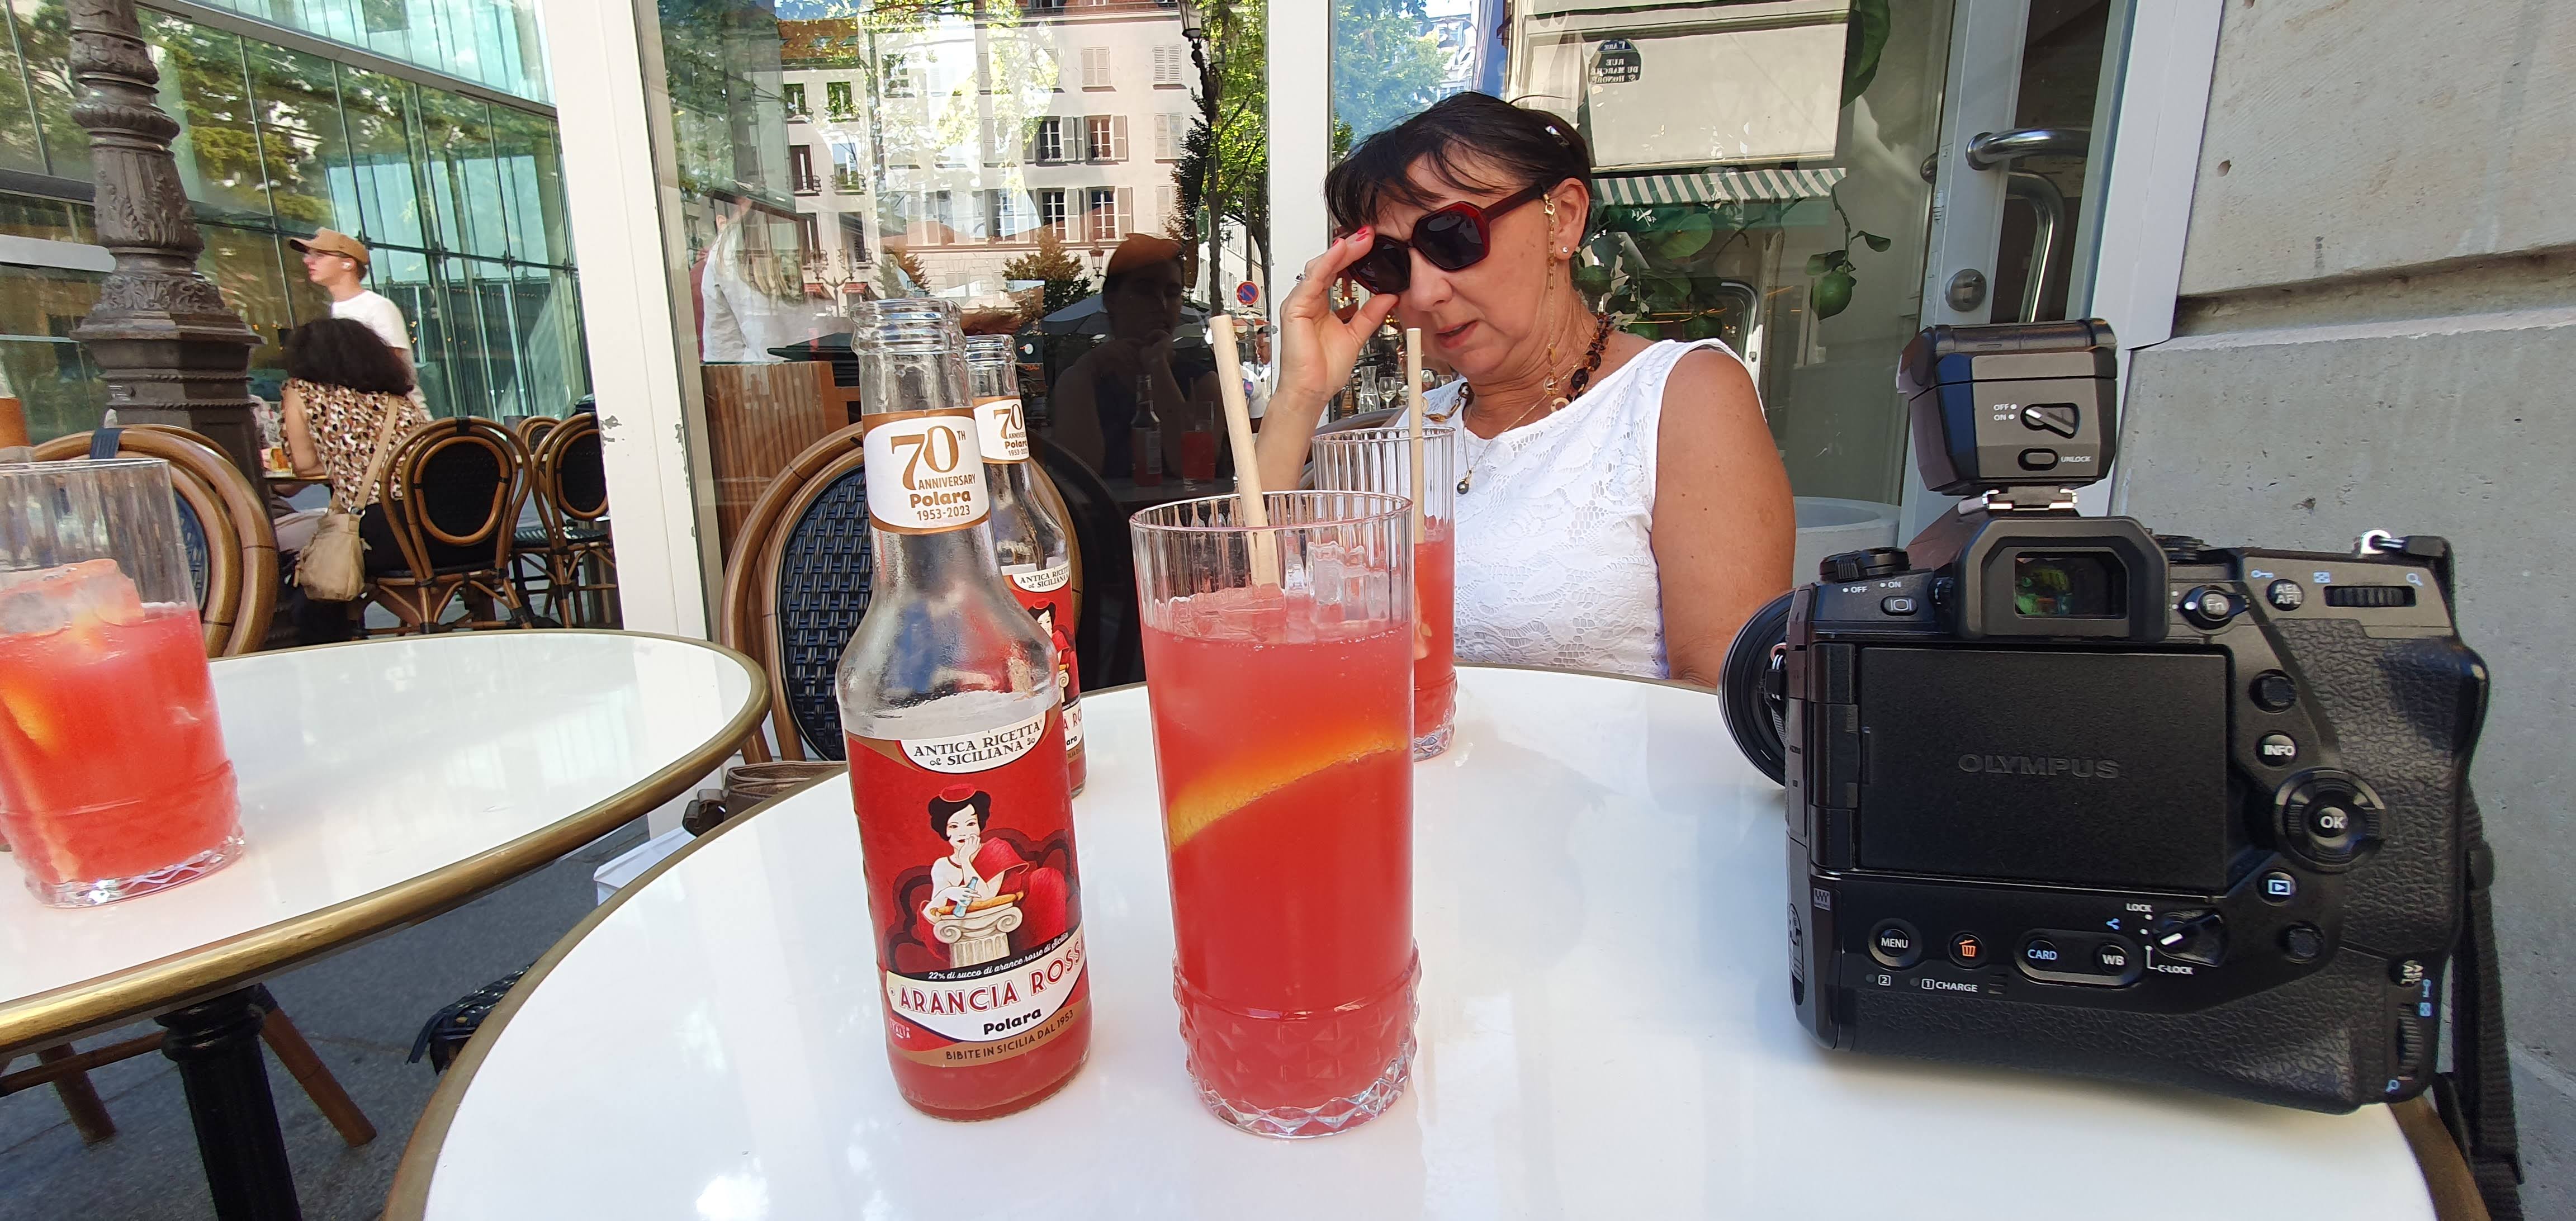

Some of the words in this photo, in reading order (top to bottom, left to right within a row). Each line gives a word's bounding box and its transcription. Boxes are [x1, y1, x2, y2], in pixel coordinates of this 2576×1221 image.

[993, 404, 1023, 439] 70
[918, 474, 976, 490] ANNIVERSARY
[910, 490, 972, 508] Polara
[917, 505, 970, 521] 1953-2023
[1020, 573, 1050, 584] ANTICA
[2275, 584, 2301, 594] AEL
[2206, 599, 2227, 610] Fn
[2275, 595, 2302, 604] AFL
[914, 740, 977, 757] ANTICA
[982, 722, 1041, 749] RICETTA
[947, 741, 1024, 766] SICILIANA
[2264, 744, 2295, 756] INFO
[1958, 754, 2120, 779] OLYMPUS
[2319, 815, 2346, 829] OK
[2126, 903, 2152, 912] LOCK
[1881, 938, 1909, 949] MENU
[946, 971, 956, 979] di
[956, 970, 983, 979] succo
[983, 965, 995, 976] di
[994, 958, 1024, 973] arance
[1023, 950, 1043, 963] rosse
[1043, 944, 1052, 953] di
[2028, 949, 2058, 960] CARD
[2102, 954, 2125, 966] WB
[2158, 965, 2193, 975] C-LOCK
[1935, 981, 1978, 993] CHARGE
[899, 980, 1020, 1015] ARANCIA
[984, 1008, 1041, 1035] Polara
[946, 1049, 981, 1060] BIBITE
[983, 1046, 994, 1057] IN
[997, 1035, 1035, 1054] SICILIA
[1038, 1024, 1056, 1039] DAL
[1057, 1009, 1074, 1028] 1953
